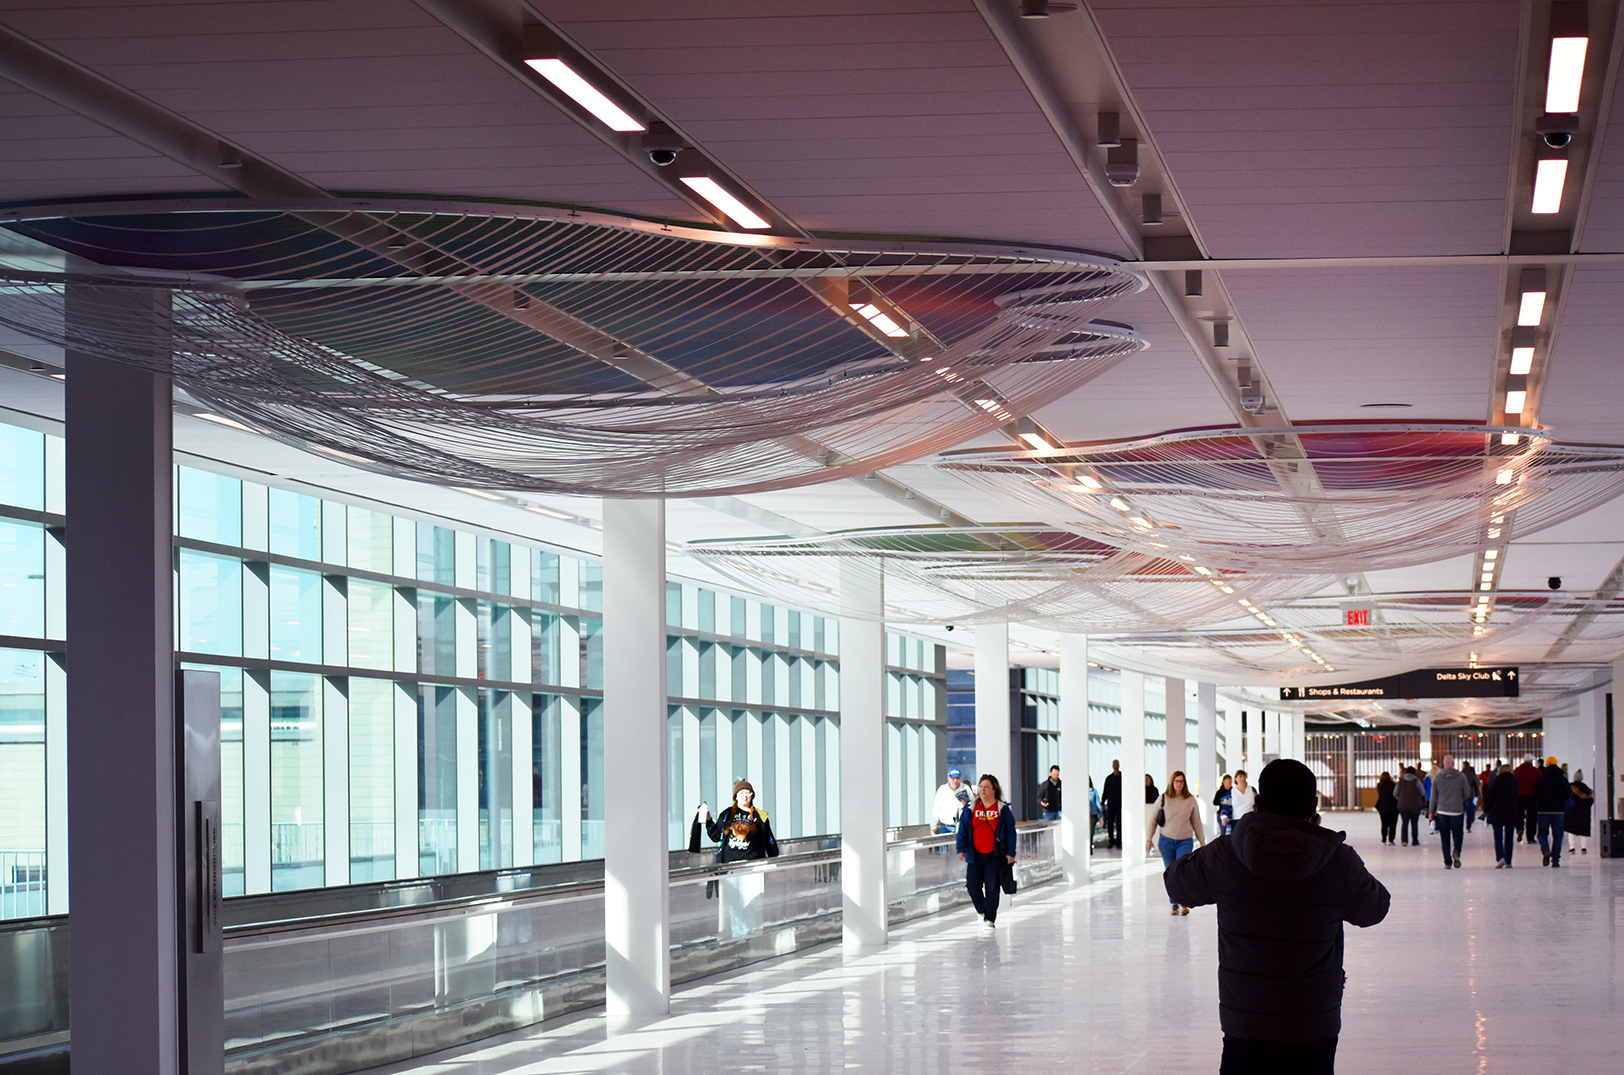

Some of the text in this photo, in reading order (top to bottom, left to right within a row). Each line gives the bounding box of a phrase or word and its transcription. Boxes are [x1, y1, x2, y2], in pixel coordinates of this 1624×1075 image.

[1347, 610, 1369, 625] EXIT
[1457, 672, 1471, 681] Sky
[1472, 672, 1490, 680] Club
[1308, 688, 1331, 696] Shops
[1340, 688, 1384, 696] Restaurants
[975, 810, 998, 818] CHEFS
